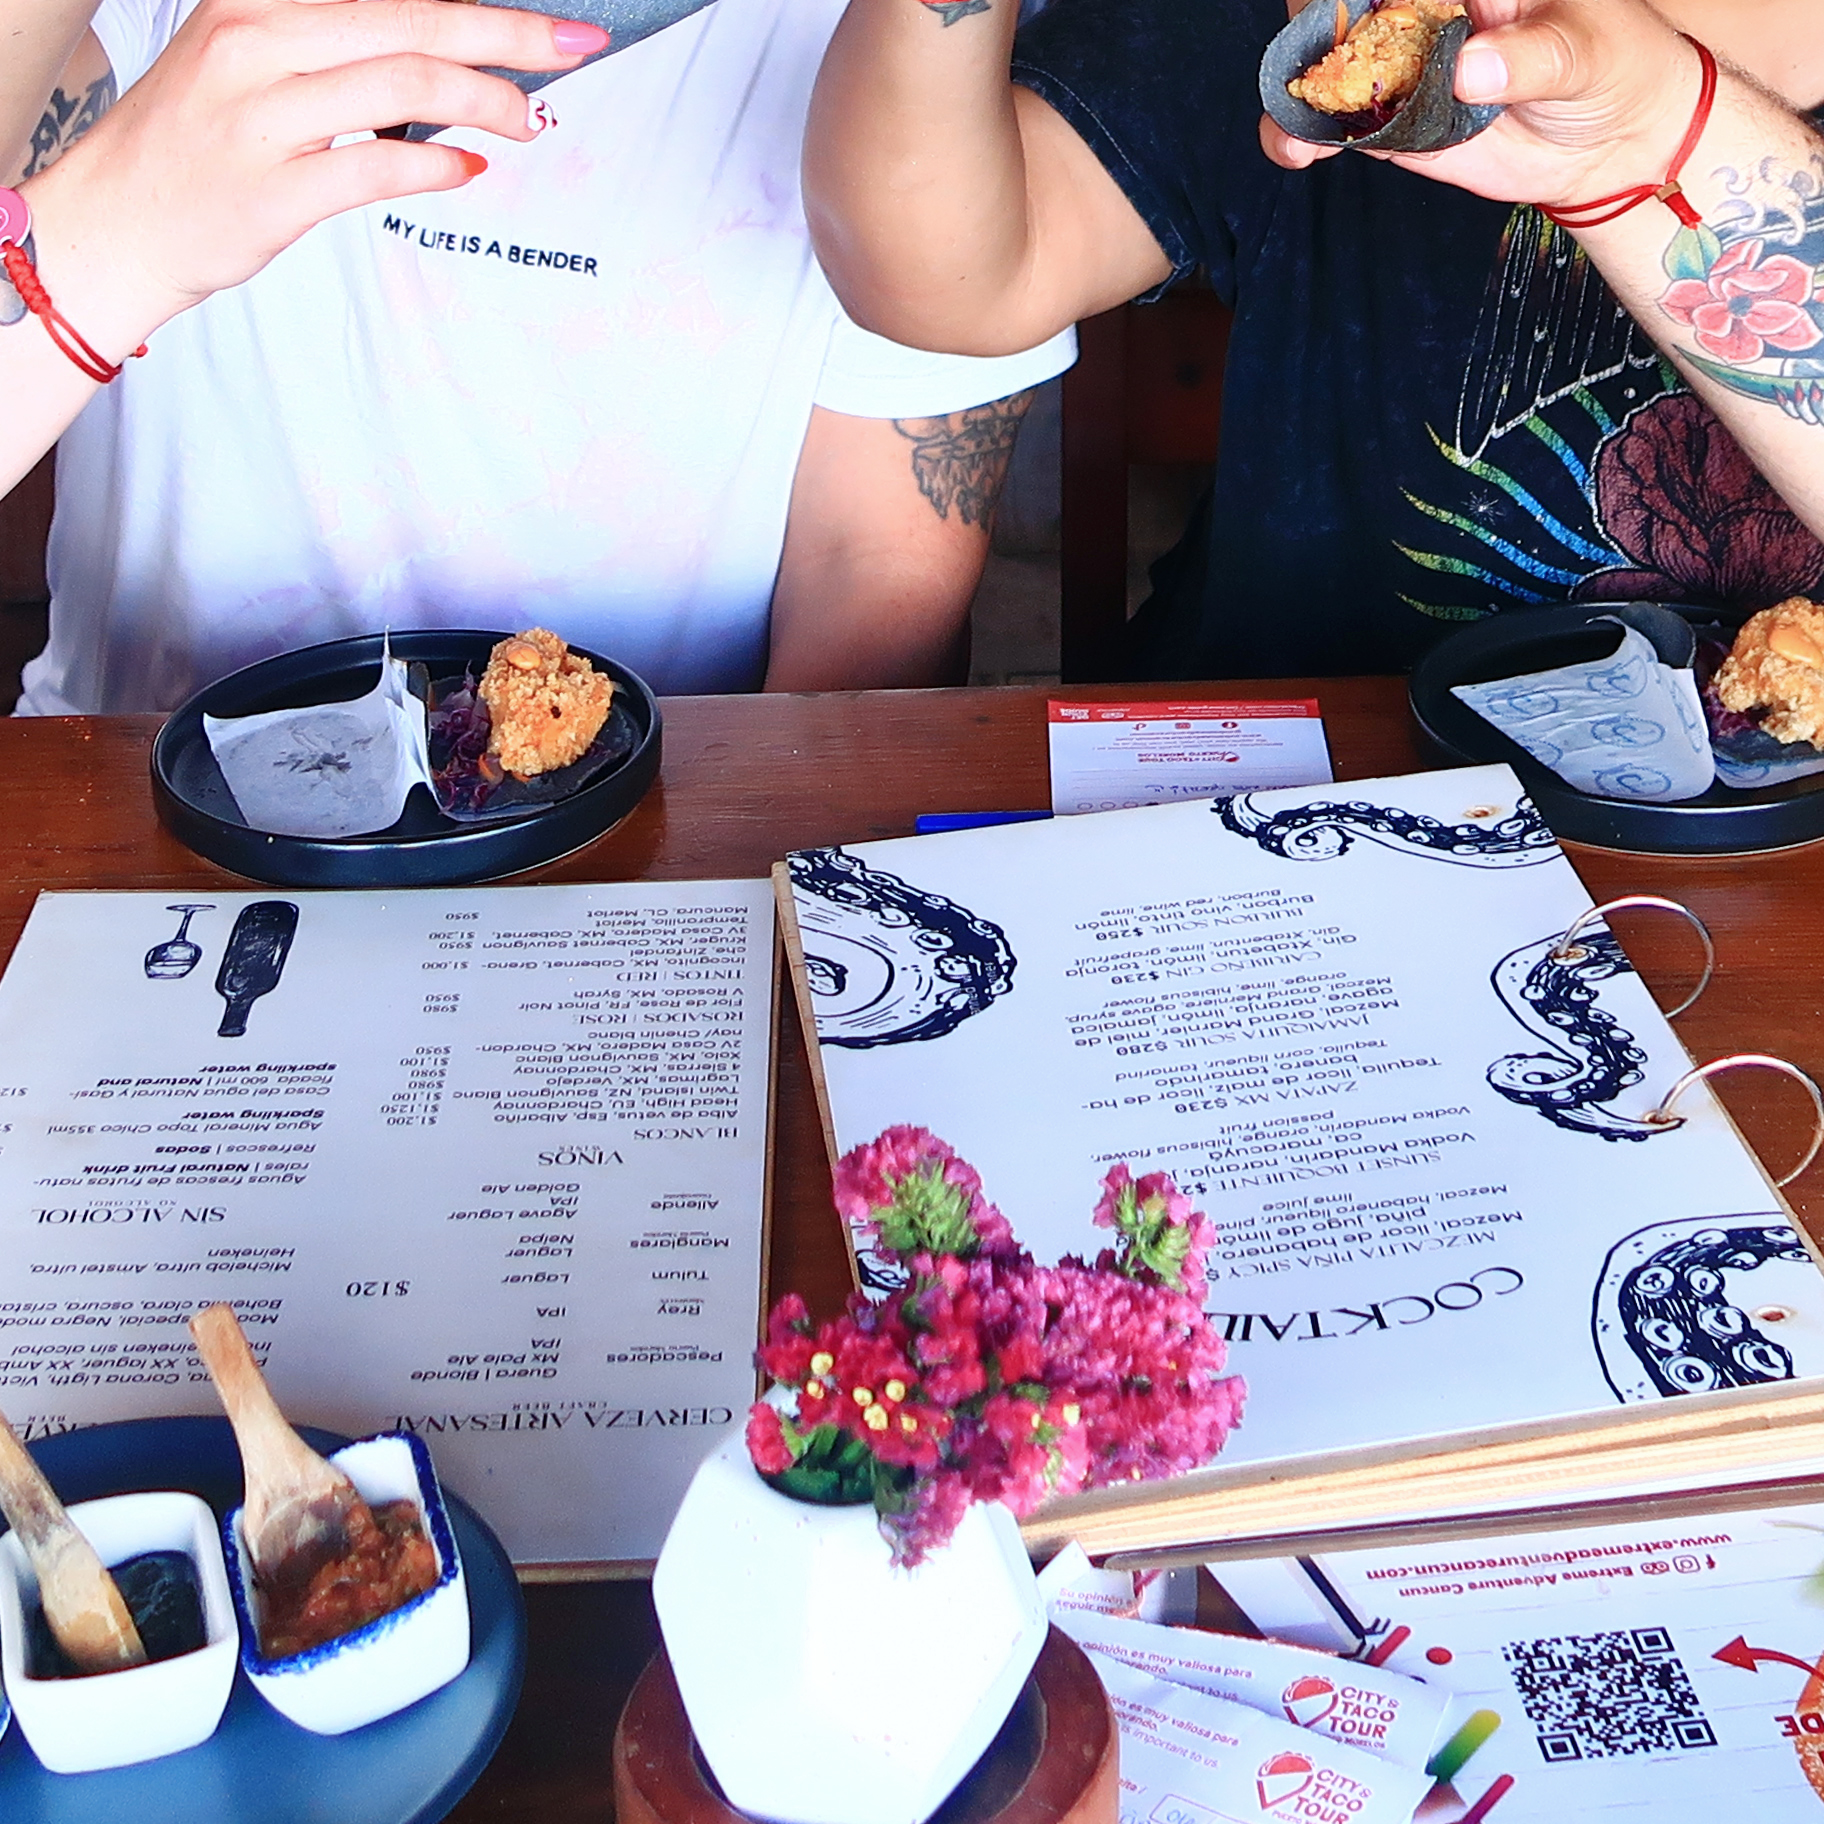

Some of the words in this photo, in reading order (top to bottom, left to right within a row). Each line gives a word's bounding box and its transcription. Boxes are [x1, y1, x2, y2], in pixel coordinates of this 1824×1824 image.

[383, 213, 416, 239] MY
[419, 228, 456, 251] LIFE
[461, 235, 481, 254] IS
[485, 240, 502, 259] A
[508, 245, 598, 277] BENDER
[1236, 894, 1315, 910] Burbon,
[1133, 911, 1186, 923] tinto,
[1187, 905, 1233, 917] vino
[1074, 918, 1130, 931] limón
[1314, 930, 1358, 946] Gin,
[1210, 935, 1313, 959] Xtabetun,
[1145, 949, 1207, 967] limón,
[673, 969, 745, 981] TINTOS
[1065, 961, 1141, 978] toronja
[616, 971, 658, 983] RED
[1273, 1051, 1359, 1071] banero,
[1154, 1065, 1270, 1088] tamarindo
[1275, 1081, 1357, 1100] ZAPATA
[1174, 1097, 1229, 1114] $230
[1234, 1093, 1270, 1106] MX
[182, 1111, 235, 1121] water
[239, 1108, 325, 1121] Sparkling
[634, 1127, 738, 1140] BLANCOS
[1328, 1128, 1363, 1144] ca,
[1404, 1132, 1476, 1149] Vodka
[155, 1145, 213, 1156] Sodas
[226, 1144, 317, 1154] Refrescos
[1208, 1137, 1323, 1163] maracuyá
[1284, 1142, 1399, 1165] Mandarin,
[538, 1149, 624, 1166] VINOS
[82, 1165, 130, 1175] drink
[133, 1164, 178, 1175] Fruit
[179, 1163, 251, 1174] Natural
[264, 1163, 310, 1173] rales
[1184, 1158, 1279, 1179] naranja,
[34, 1178, 84, 1188] natu-
[87, 1177, 144, 1188] frutas
[146, 1176, 172, 1188] de
[175, 1175, 244, 1186] frescas
[248, 1172, 307, 1185] Aguas
[481, 1184, 511, 1195] Ale
[514, 1183, 581, 1195] Golden
[550, 1196, 579, 1207] IPA
[651, 1200, 720, 1212] Allende
[32, 1208, 172, 1224] ALCOHOL
[181, 1207, 227, 1224] SIN
[447, 1209, 515, 1221] Laguer
[518, 1206, 579, 1220] Agave
[1369, 1205, 1427, 1224] piña,
[1312, 1214, 1364, 1233] jugo
[1434, 1211, 1523, 1233] Mezcal,
[1277, 1225, 1307, 1238] de
[1343, 1231, 1373, 1244] de
[1380, 1224, 1430, 1239] licor
[630, 1236, 730, 1250] Manglares
[1216, 1236, 1338, 1261] habanero,
[207, 1248, 296, 1261] Heineken
[505, 1245, 574, 1258] Laguer
[501, 1271, 570, 1284] Laguer
[652, 1270, 709, 1282] Tulum
[346, 1280, 411, 1297] $120
[536, 1307, 567, 1318] IPA
[657, 1302, 704, 1316] Rrey
[11, 1344, 86, 1357] alcohol
[90, 1344, 119, 1356] sin
[121, 1341, 202, 1354] eineken
[531, 1338, 562, 1350] IPA
[447, 1355, 480, 1367] Ale
[483, 1353, 527, 1367] Pale
[531, 1352, 560, 1366] Mx
[607, 1350, 723, 1365] Pescadores
[411, 1369, 481, 1383] Blonde
[495, 1367, 558, 1379] Guera
[584, 1407, 733, 1429] CERVEZA
[1364, 1532, 1733, 1582] www.extremeadventurecancun.com
[1562, 1564, 1634, 1583] Extreme
[1468, 1572, 1559, 1593] Adventure
[1398, 1582, 1464, 1600] Cancun
[1339, 1686, 1386, 1706] CITY
[1340, 1700, 1396, 1723] TACO
[1329, 1715, 1388, 1739] TOUR
[1132, 1728, 1188, 1758] important
[1316, 1768, 1360, 1794] CITY
[1311, 1782, 1364, 1812] TACO
[1294, 1795, 1350, 1824] TOUR
